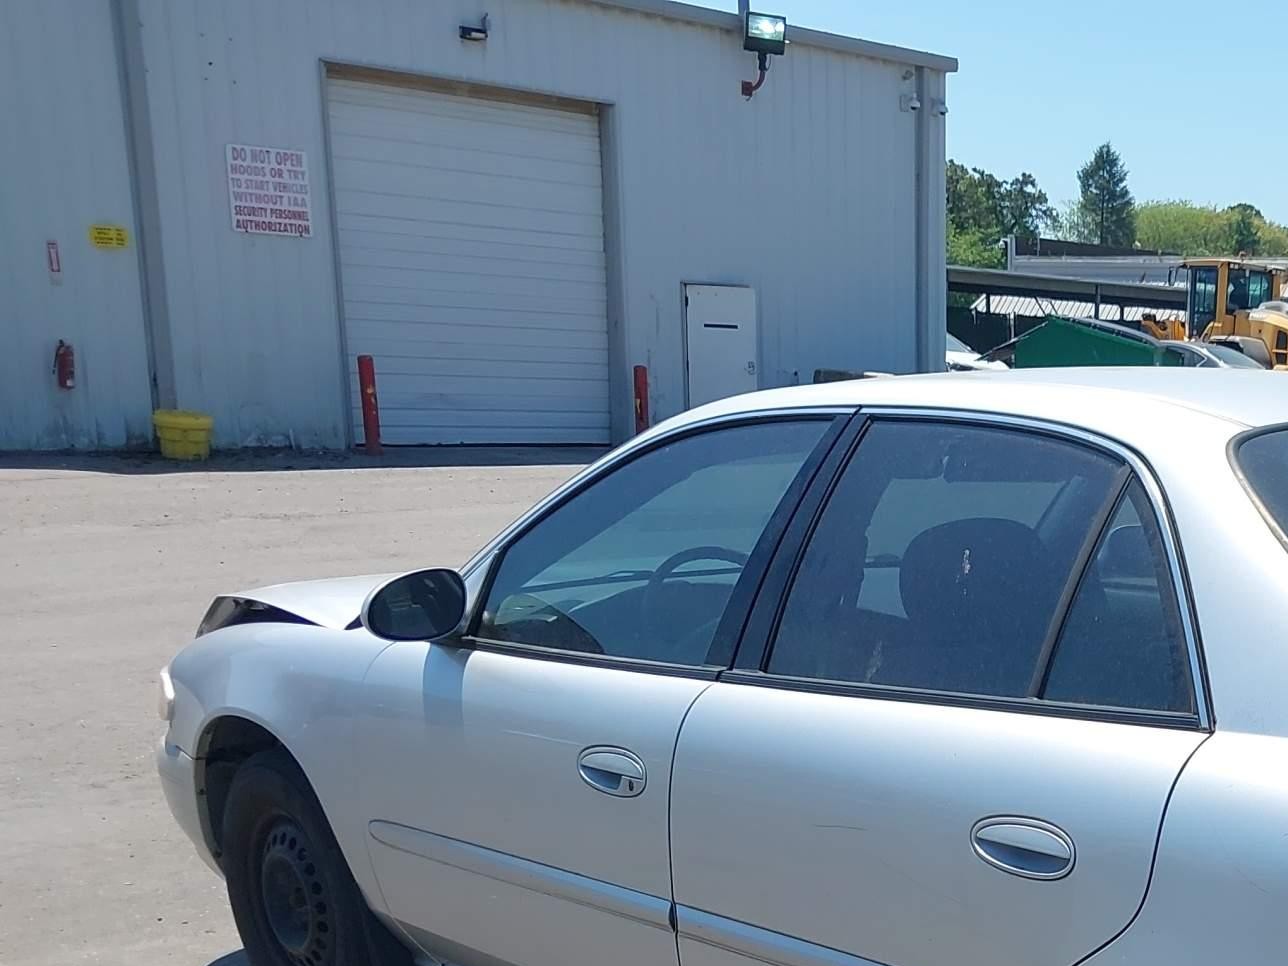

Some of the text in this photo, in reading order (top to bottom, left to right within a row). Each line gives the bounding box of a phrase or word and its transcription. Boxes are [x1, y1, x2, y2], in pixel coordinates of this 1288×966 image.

[231, 147, 303, 168] DO NOT OPEN
[230, 163, 306, 181] HOODS OR TRY
[231, 177, 309, 195] TO START VEHICLES
[232, 191, 308, 208] WITHOUT IAA
[234, 205, 310, 222] SECURITY PERSONNEL
[235, 219, 311, 235] AUTHORIZATION
